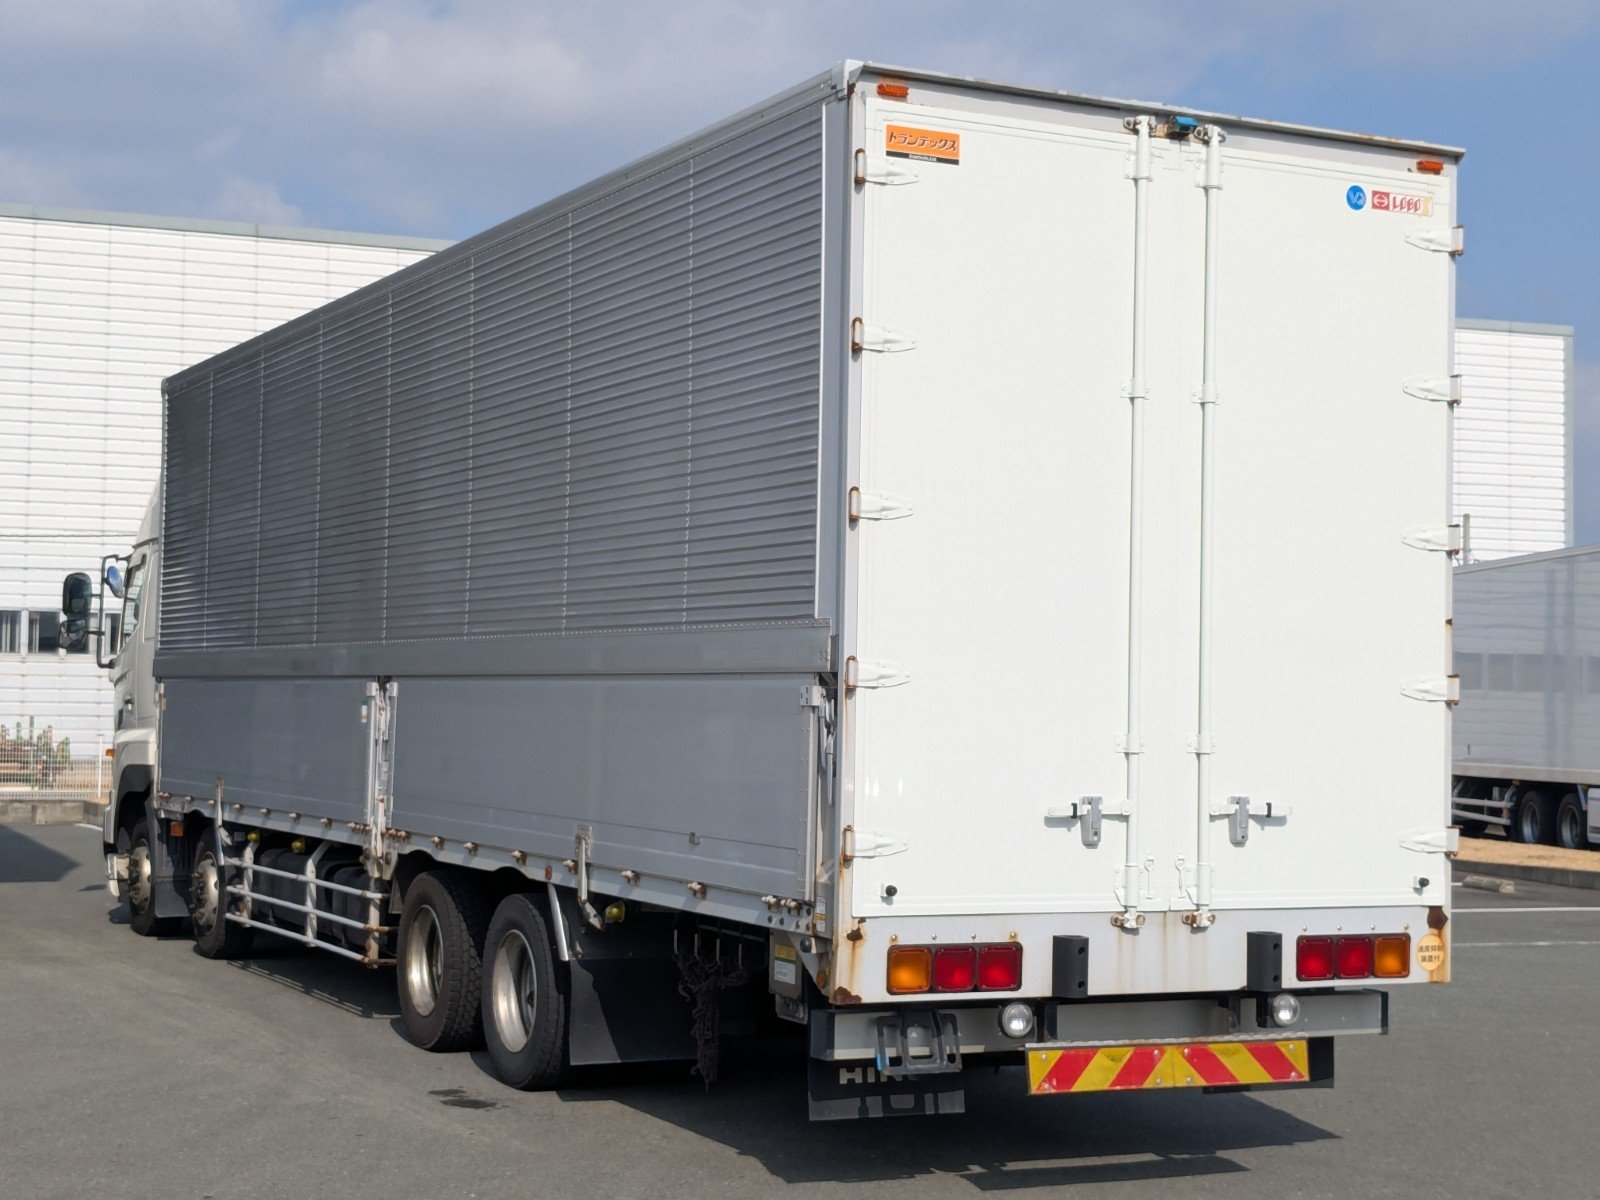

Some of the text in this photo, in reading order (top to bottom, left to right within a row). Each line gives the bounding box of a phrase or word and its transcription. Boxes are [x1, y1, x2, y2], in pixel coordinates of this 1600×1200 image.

[888, 131, 957, 152] トランテックス
[839, 1067, 919, 1085] HI
